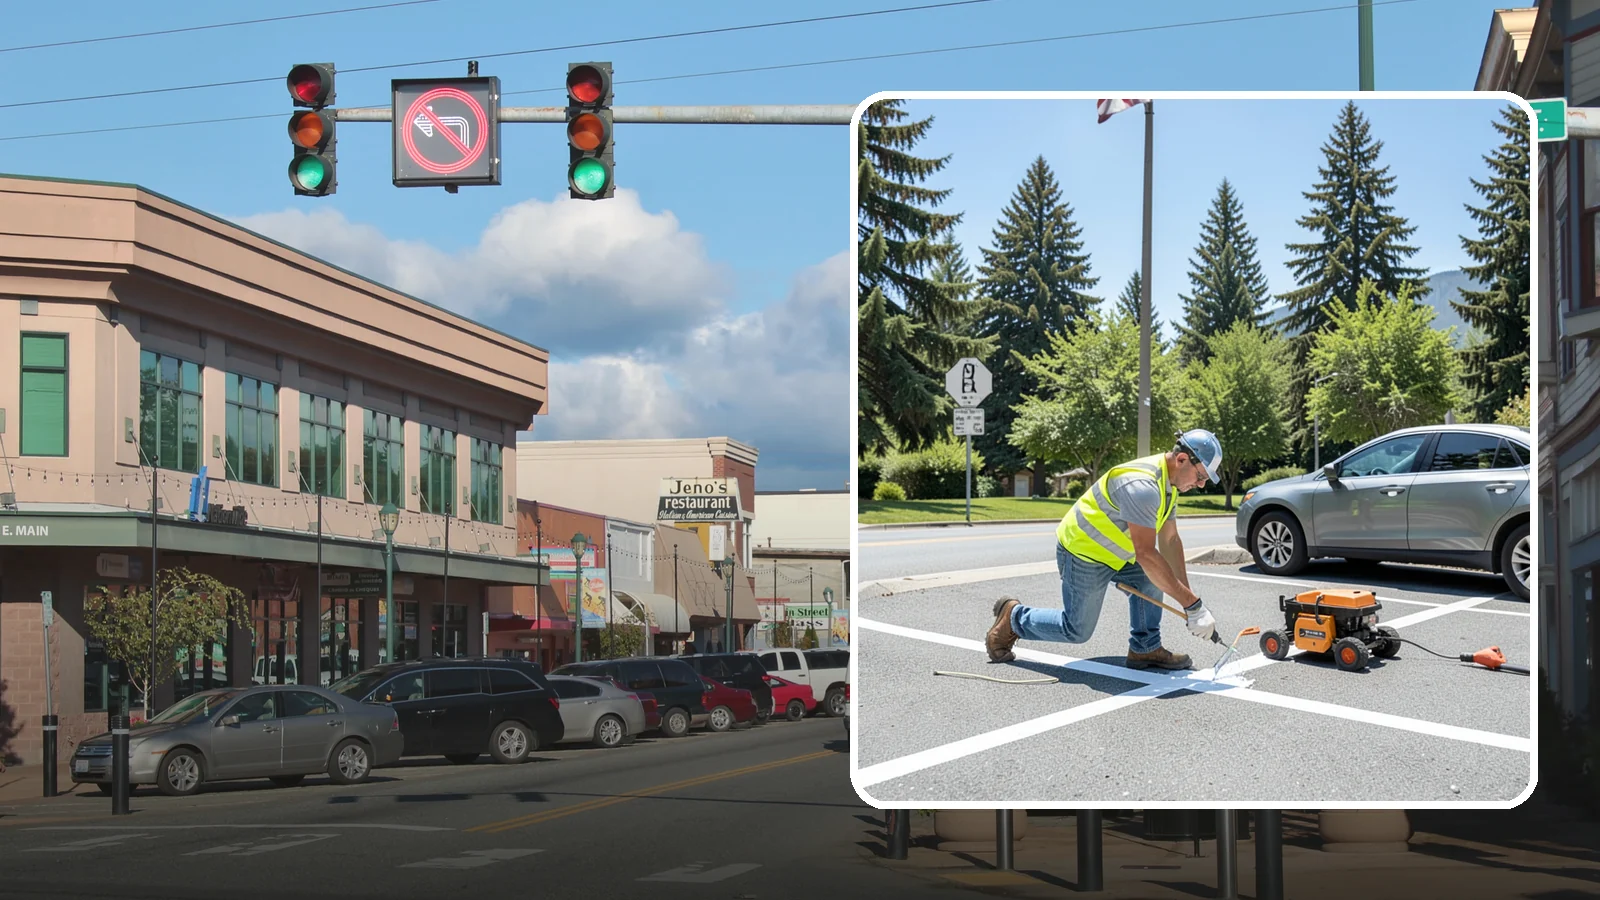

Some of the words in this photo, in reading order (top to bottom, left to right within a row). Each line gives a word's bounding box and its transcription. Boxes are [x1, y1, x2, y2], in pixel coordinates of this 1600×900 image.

[670, 480, 728, 495] Jeno's
[665, 496, 731, 509] restaurant
[715, 509, 738, 519] Cuisine
[2, 525, 13, 536] E.
[15, 525, 49, 536] MAIN
[797, 607, 829, 617] Street
